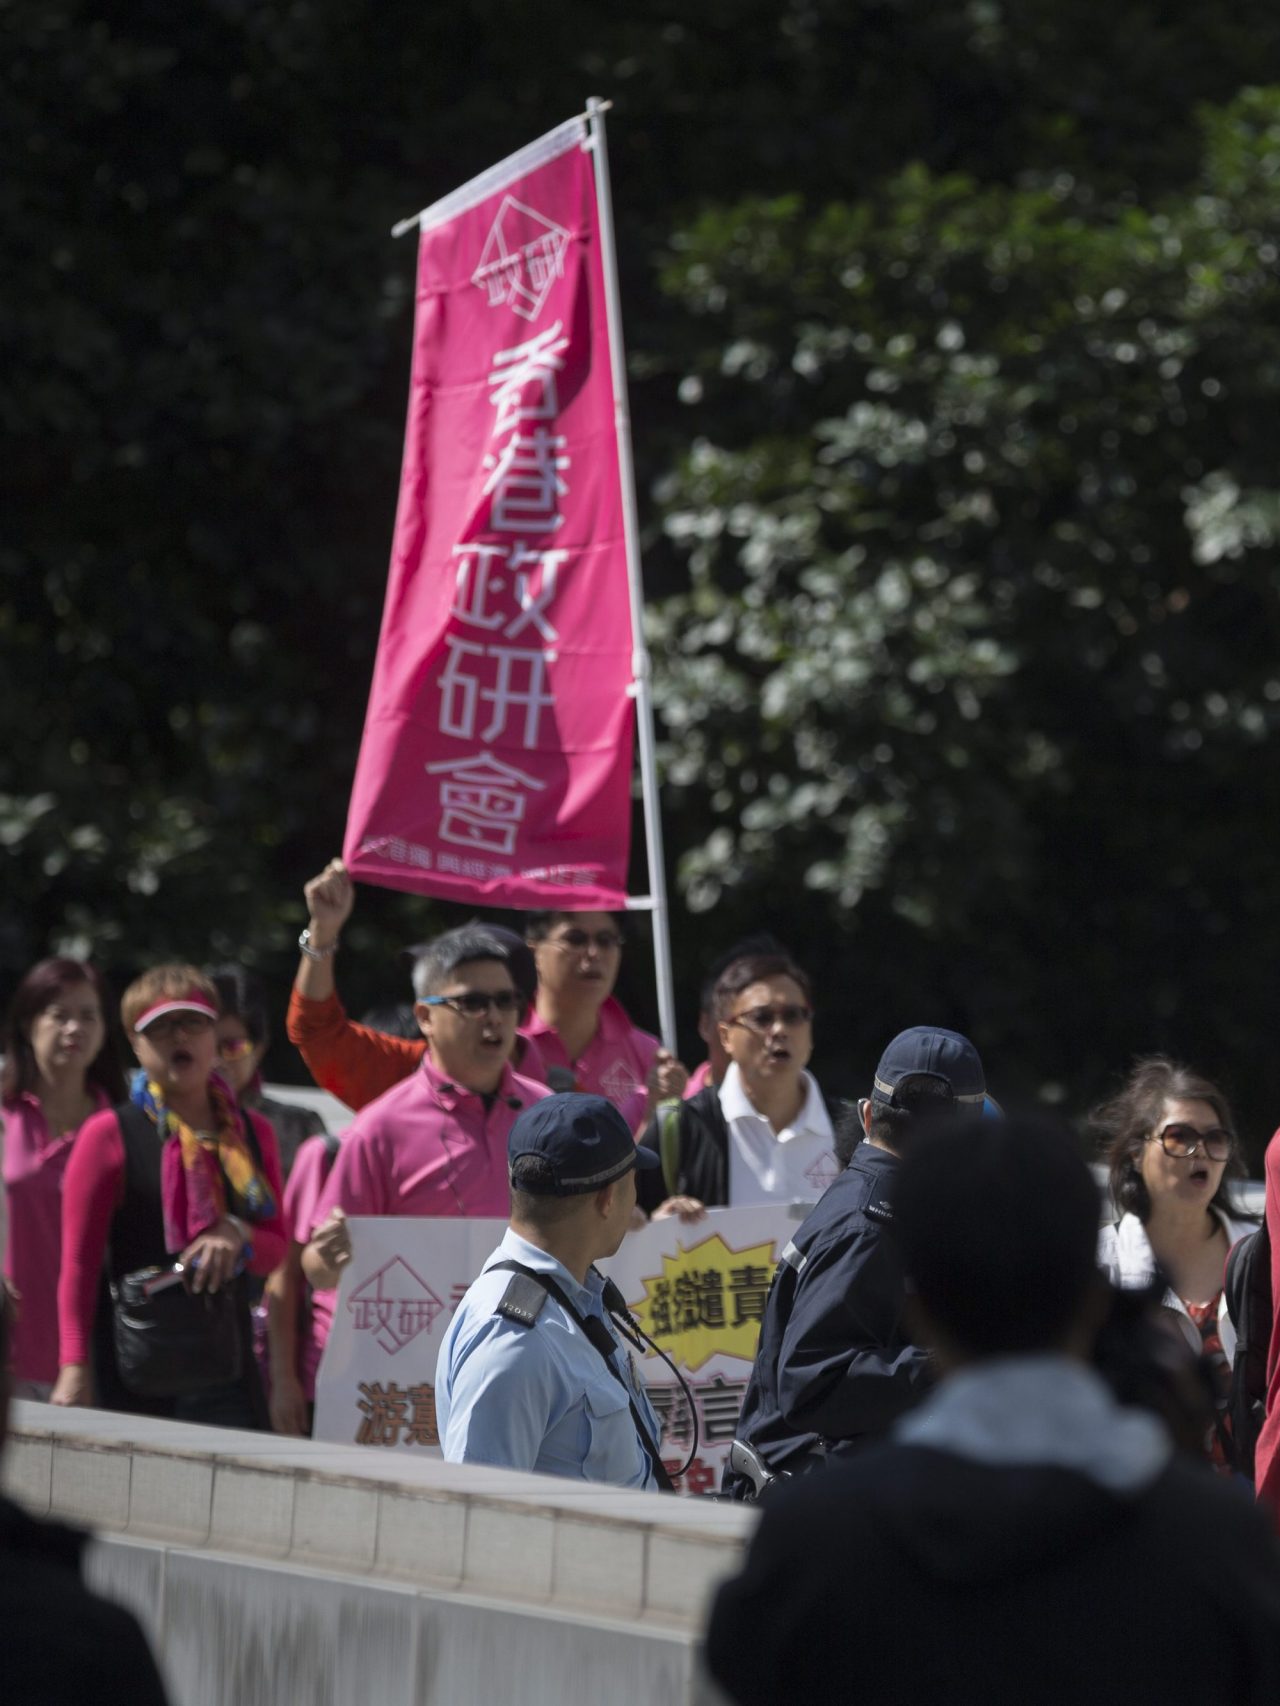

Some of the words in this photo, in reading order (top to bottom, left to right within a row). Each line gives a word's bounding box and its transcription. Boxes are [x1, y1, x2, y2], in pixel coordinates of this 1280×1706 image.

[425, 319, 571, 856] 香港政研會
